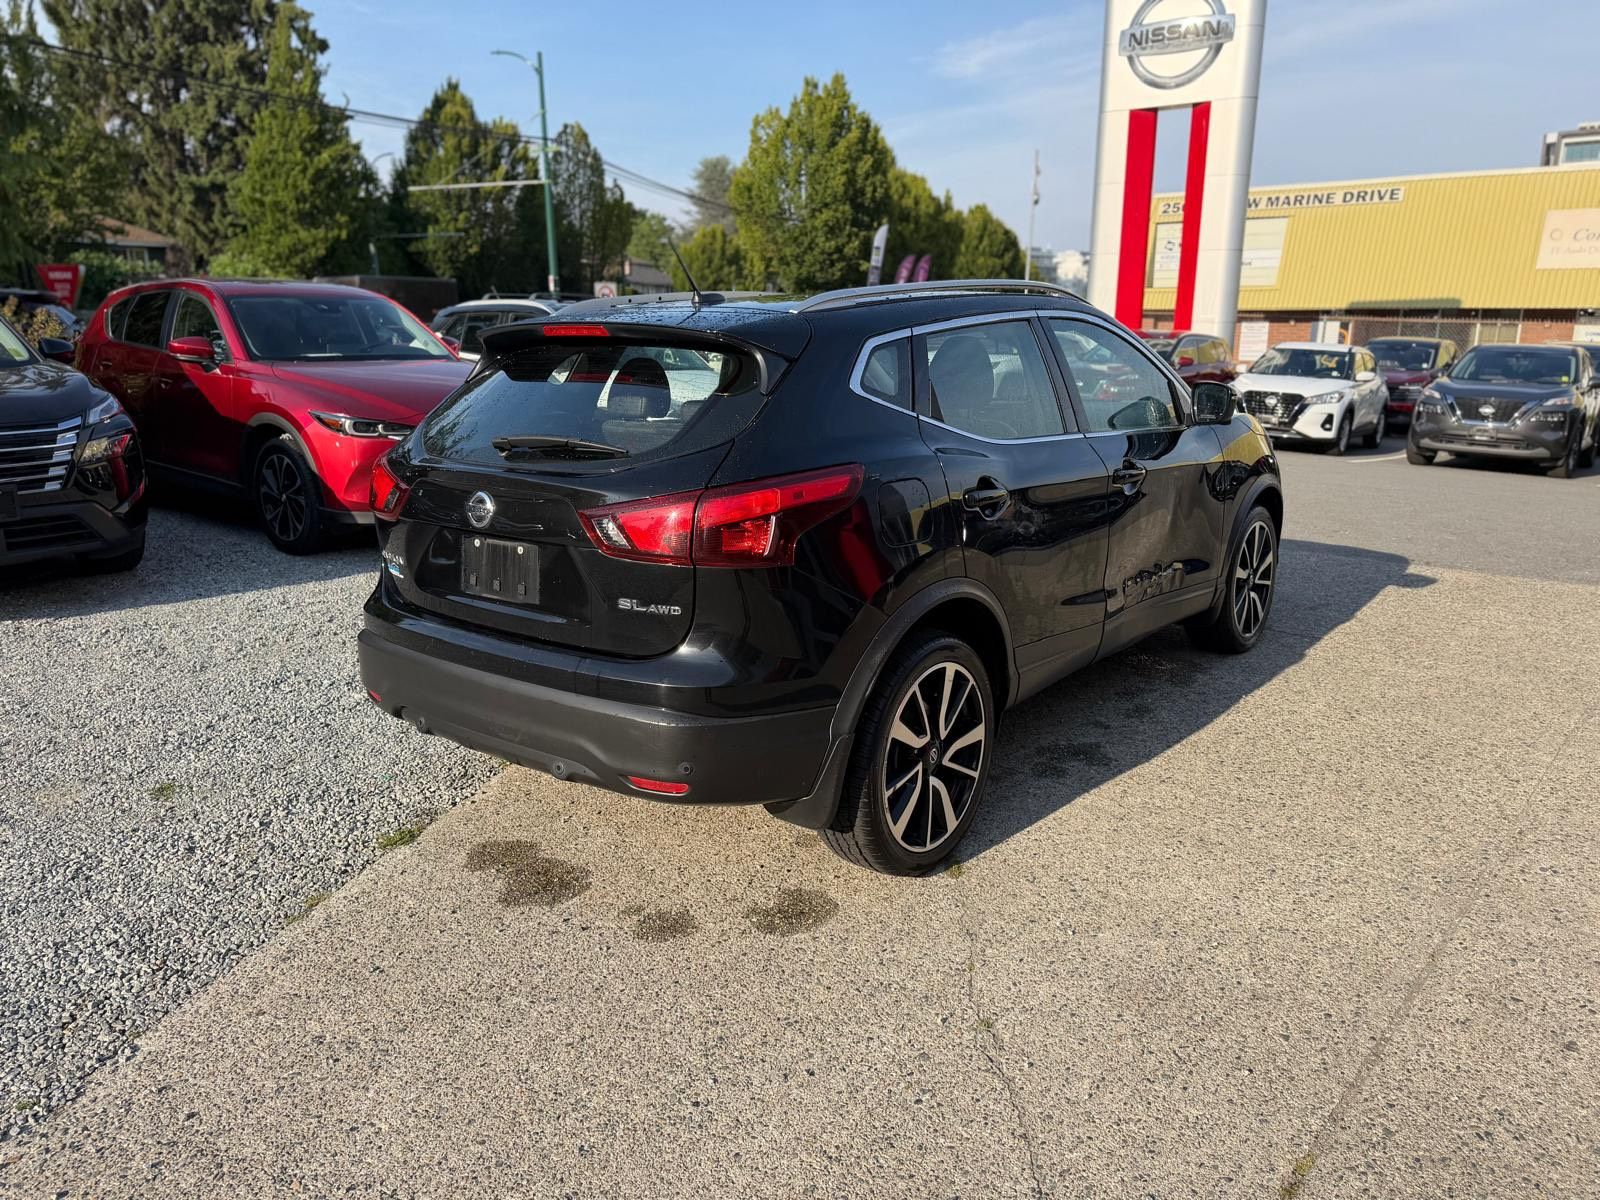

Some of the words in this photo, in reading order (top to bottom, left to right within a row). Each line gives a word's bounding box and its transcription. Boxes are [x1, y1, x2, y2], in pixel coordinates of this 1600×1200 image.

[1128, 20, 1221, 47] NISSAN
[1265, 192, 1336, 208] MARINE
[1342, 188, 1401, 203] DRIVE
[647, 604, 681, 615] AWD
